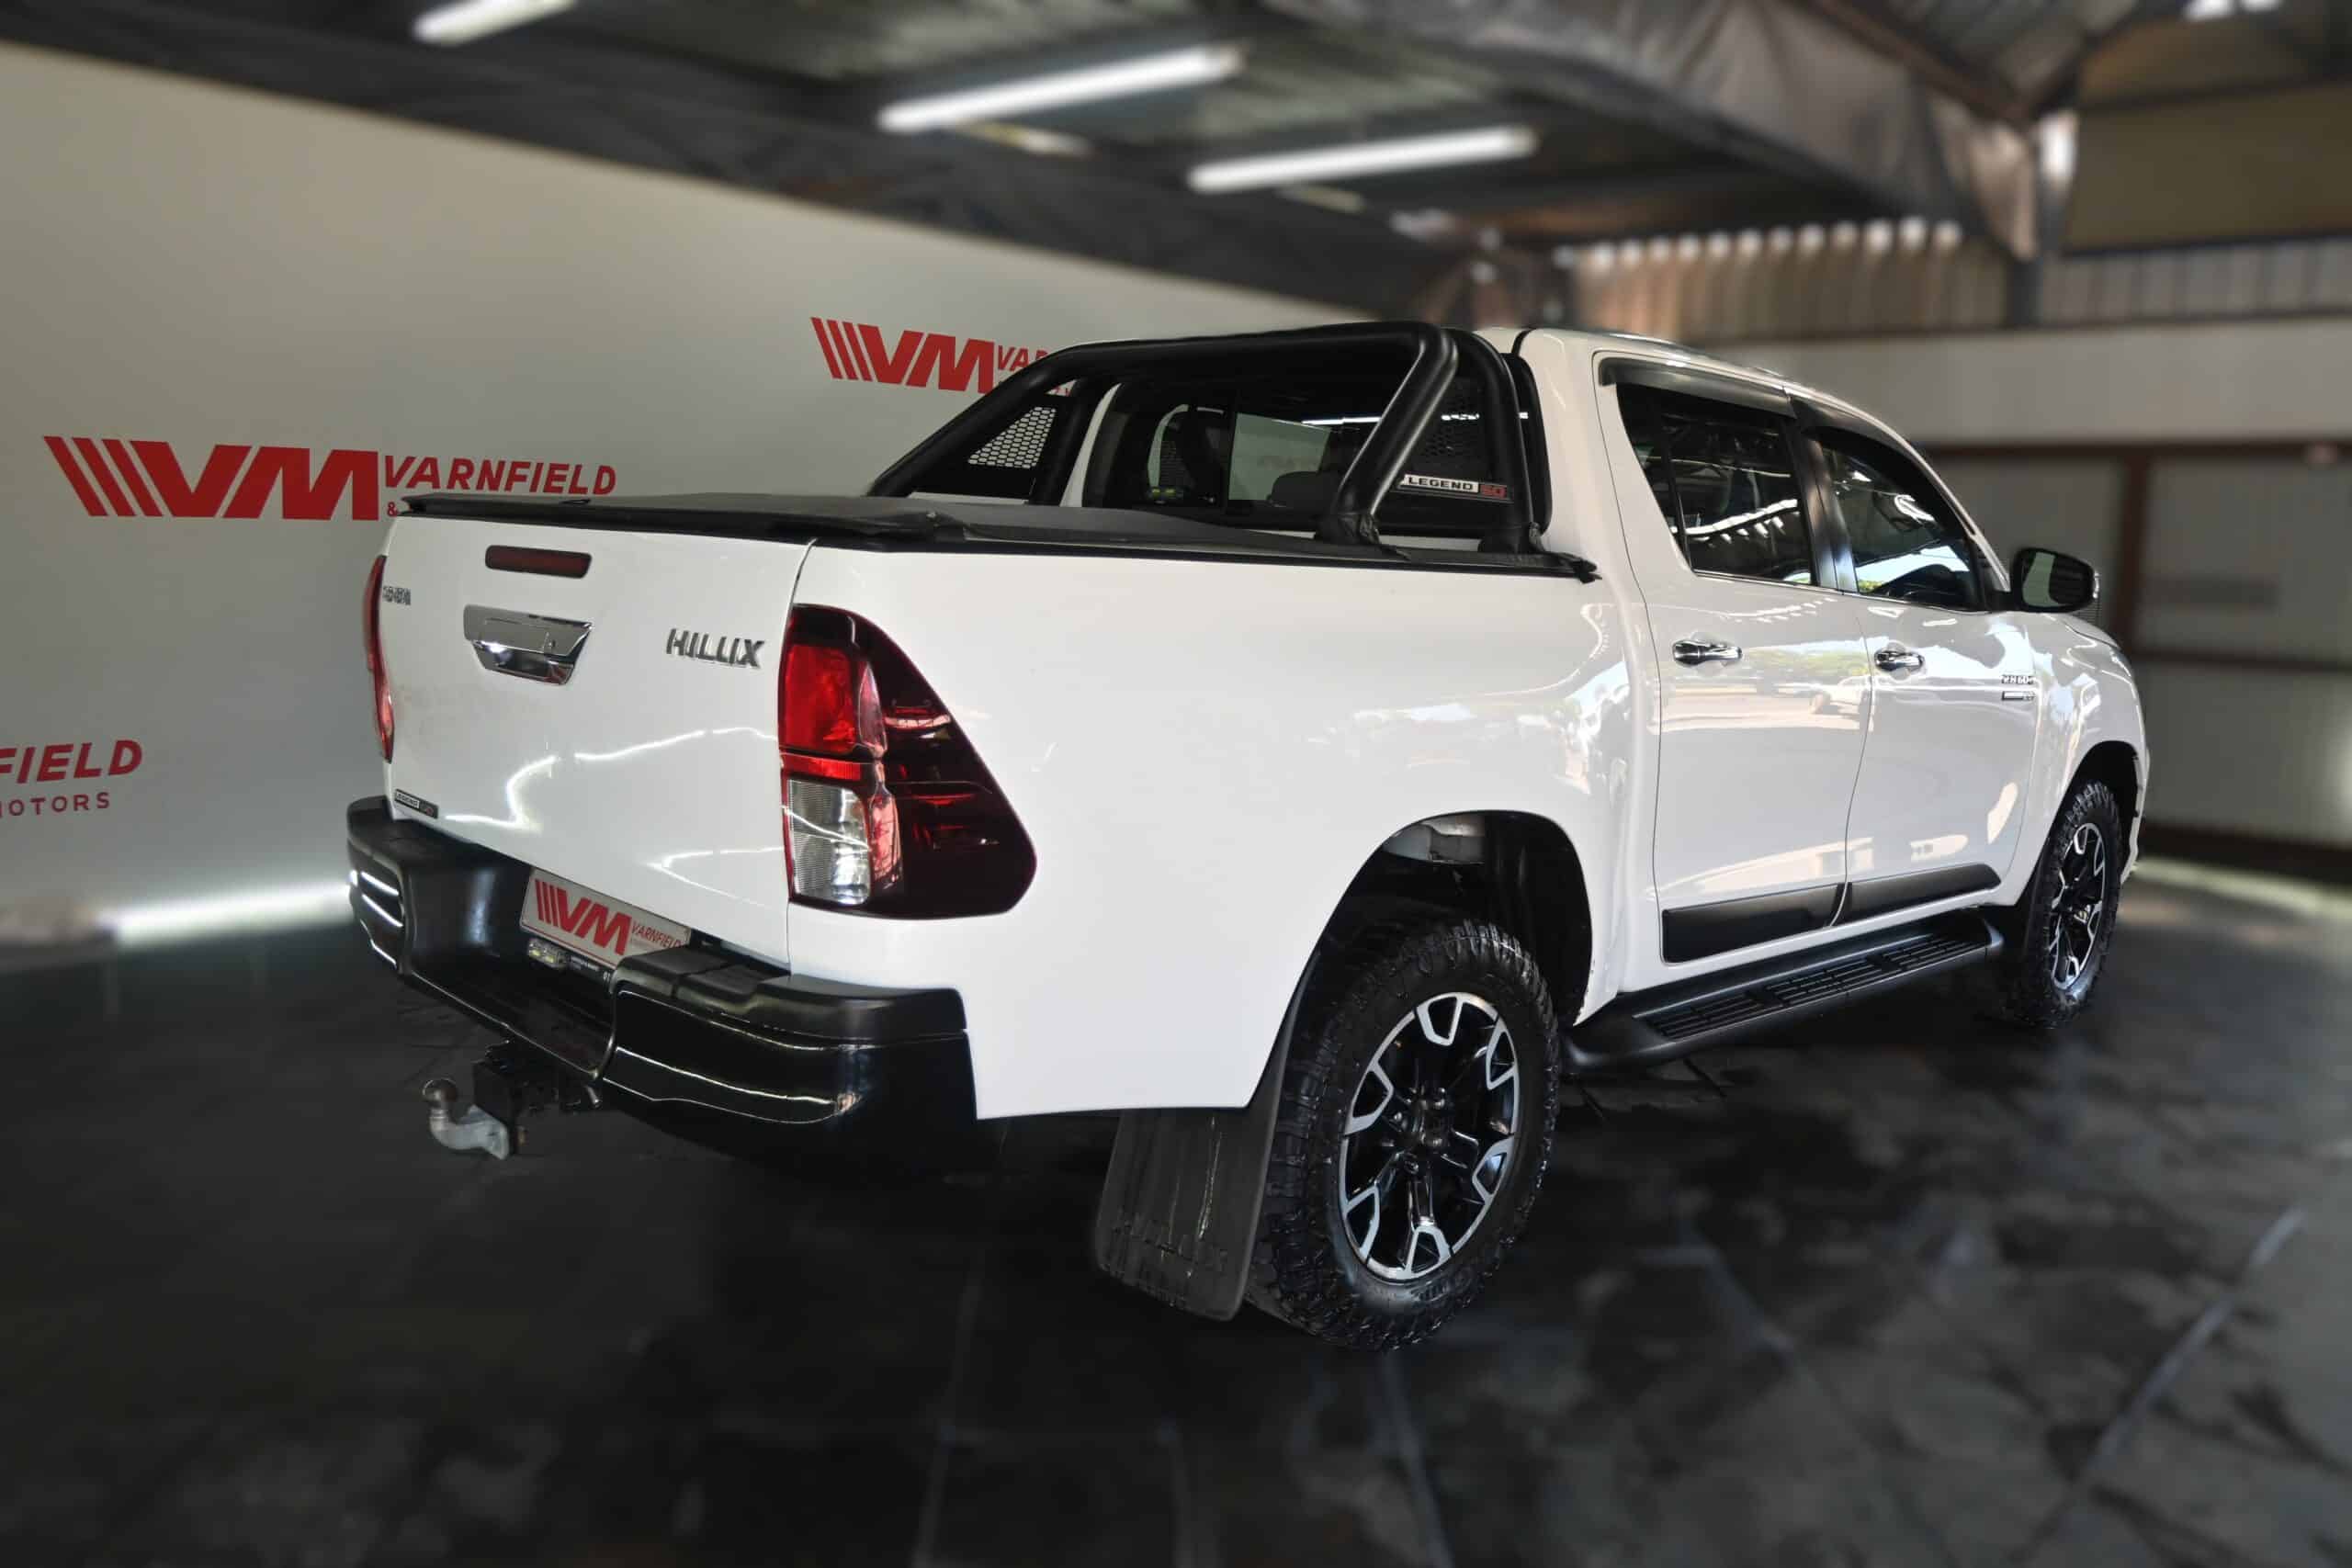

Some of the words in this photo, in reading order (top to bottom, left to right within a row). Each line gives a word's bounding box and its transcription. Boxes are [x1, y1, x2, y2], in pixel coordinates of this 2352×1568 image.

[857, 323, 994, 394] VM
[998, 345, 1048, 371] VA
[130, 441, 379, 521] VM
[385, 456, 616, 495] VARNFIELD
[1408, 476, 1474, 491] LEGEND
[666, 628, 764, 668] HILUX
[0, 792, 110, 818] OTORS
[557, 887, 632, 955] VM
